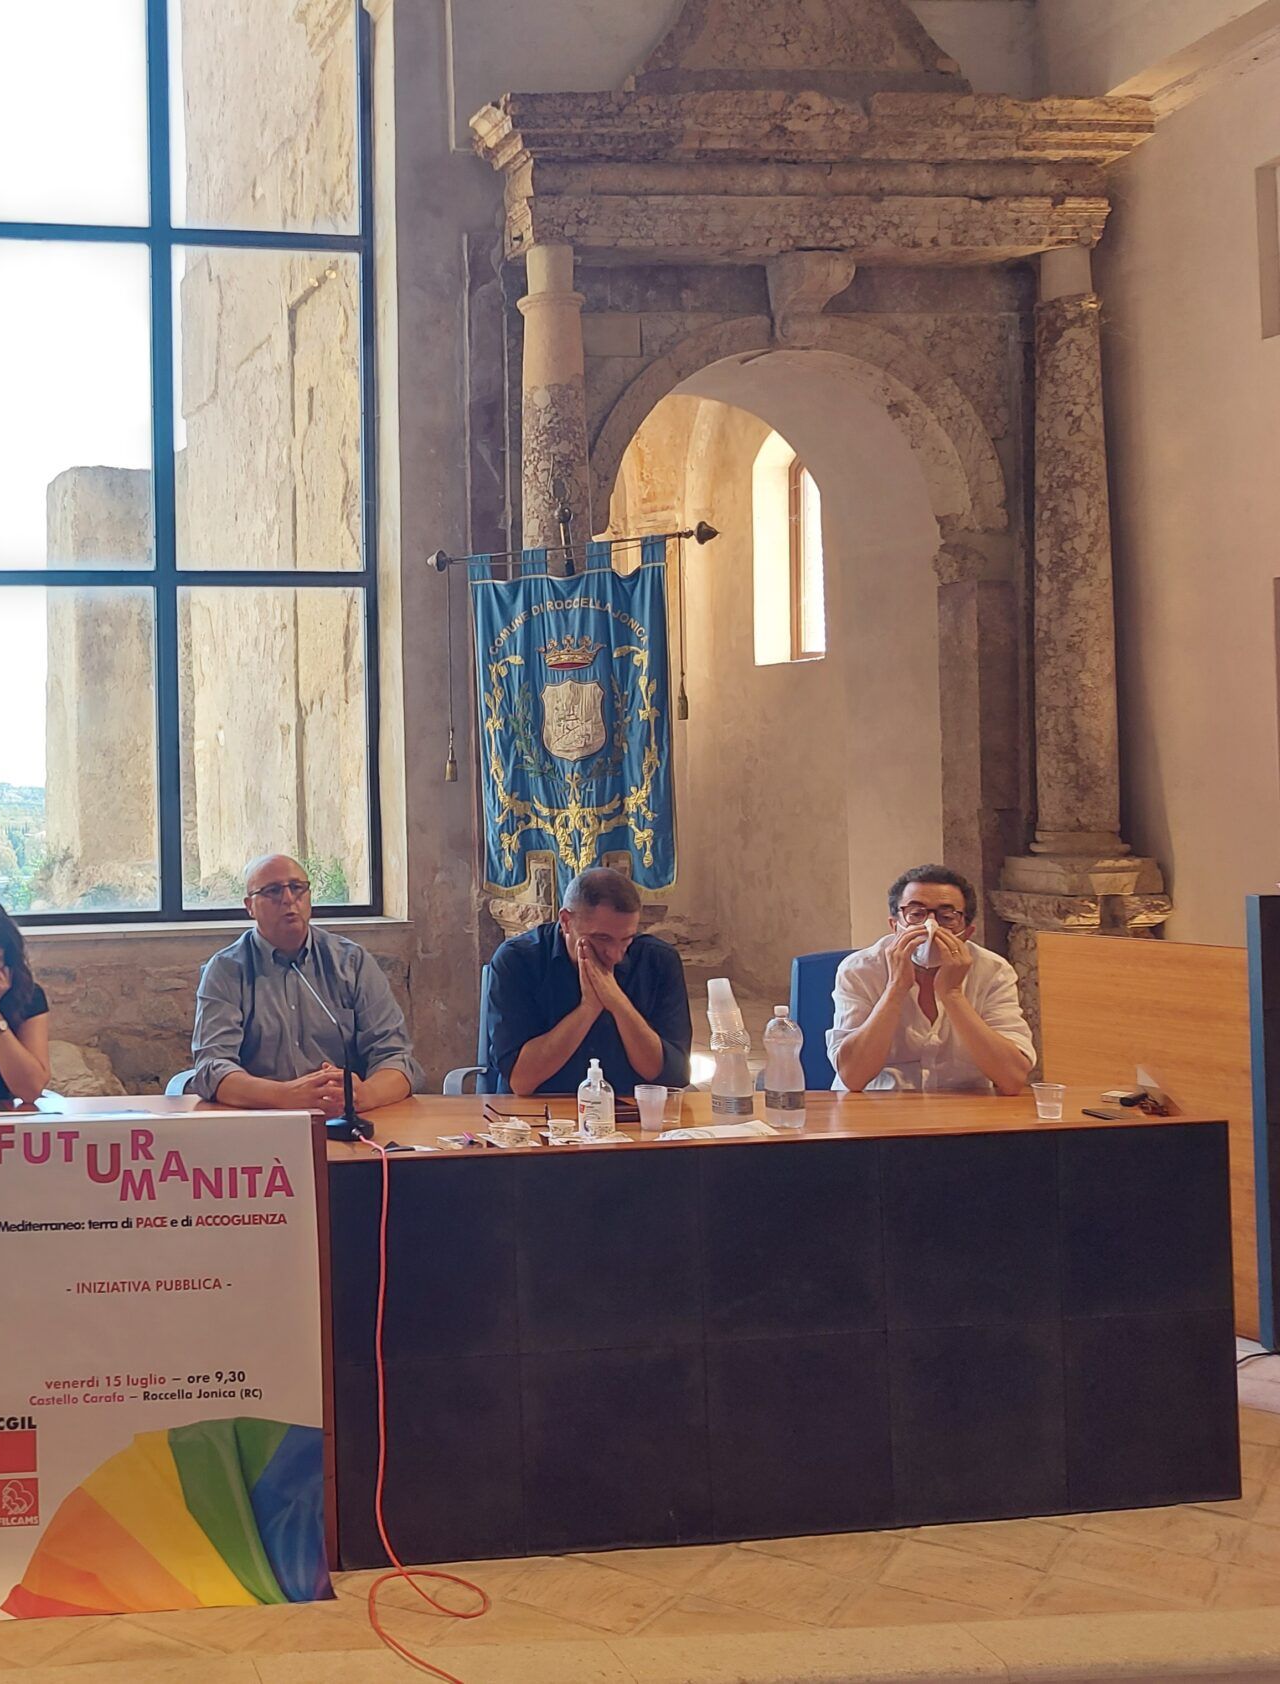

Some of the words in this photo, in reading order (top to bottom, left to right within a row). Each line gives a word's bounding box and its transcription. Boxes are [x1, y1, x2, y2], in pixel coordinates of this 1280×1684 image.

[489, 610, 530, 655] COMUNE
[531, 604, 545, 617] DI
[546, 597, 613, 613] ROCCELLA
[612, 609, 649, 646] JONICA
[88, 1219, 118, 1229] terra
[121, 1217, 133, 1229] di
[136, 1216, 168, 1228] PACE
[170, 1218, 178, 1227] e
[181, 1215, 192, 1227] di
[195, 1213, 287, 1227] ACCOGLIENZA
[76, 1281, 151, 1294] INIZIATIVA
[156, 1278, 223, 1292] PUBBLICA
[105, 1375, 122, 1387] 15
[126, 1373, 167, 1389] luglio
[187, 1374, 211, 1385] ore
[214, 1371, 246, 1385] 9,30
[29, 1394, 79, 1406] Castello
[82, 1391, 125, 1404] Carafa
[143, 1390, 193, 1401] Roccella
[196, 1388, 236, 1400] Jonica
[239, 1387, 263, 1400] (RC)
